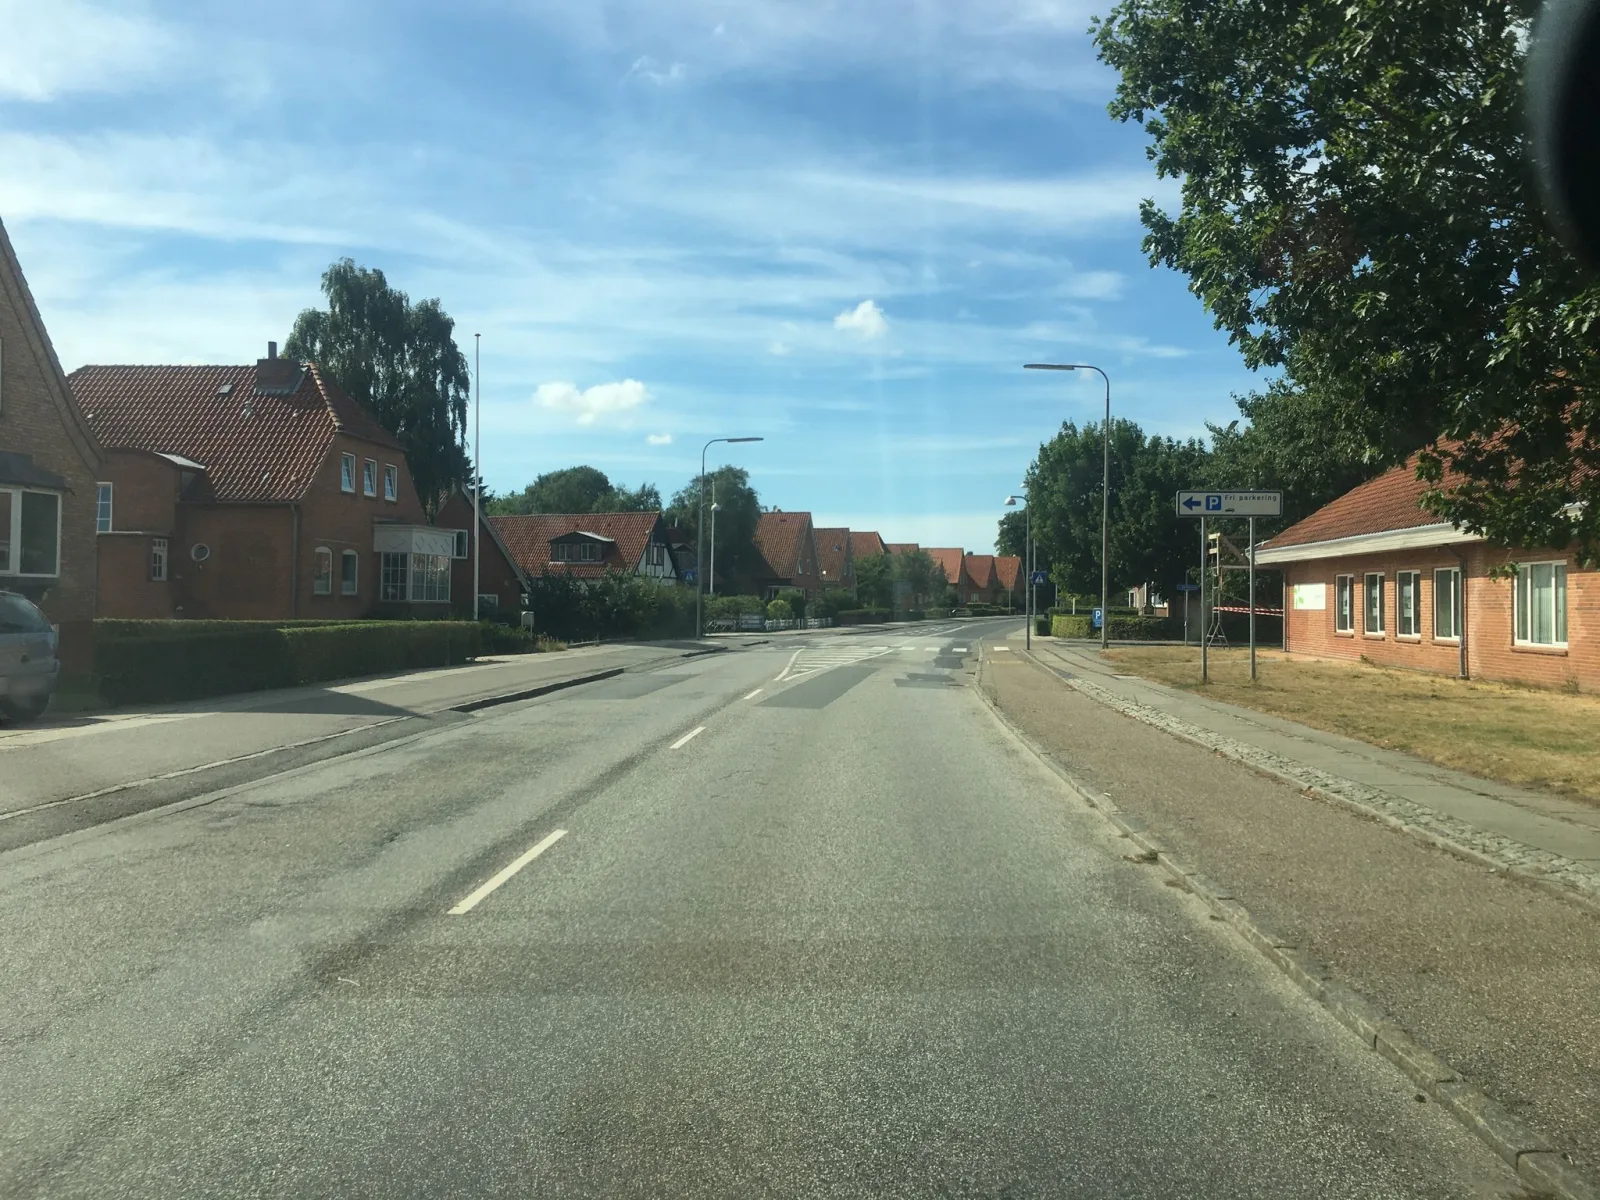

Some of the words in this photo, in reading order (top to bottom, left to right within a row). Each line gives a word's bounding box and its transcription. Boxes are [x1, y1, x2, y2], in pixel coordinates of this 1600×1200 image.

[1239, 494, 1277, 502] parkering
[1209, 497, 1219, 510] P
[1096, 610, 1100, 620] P
